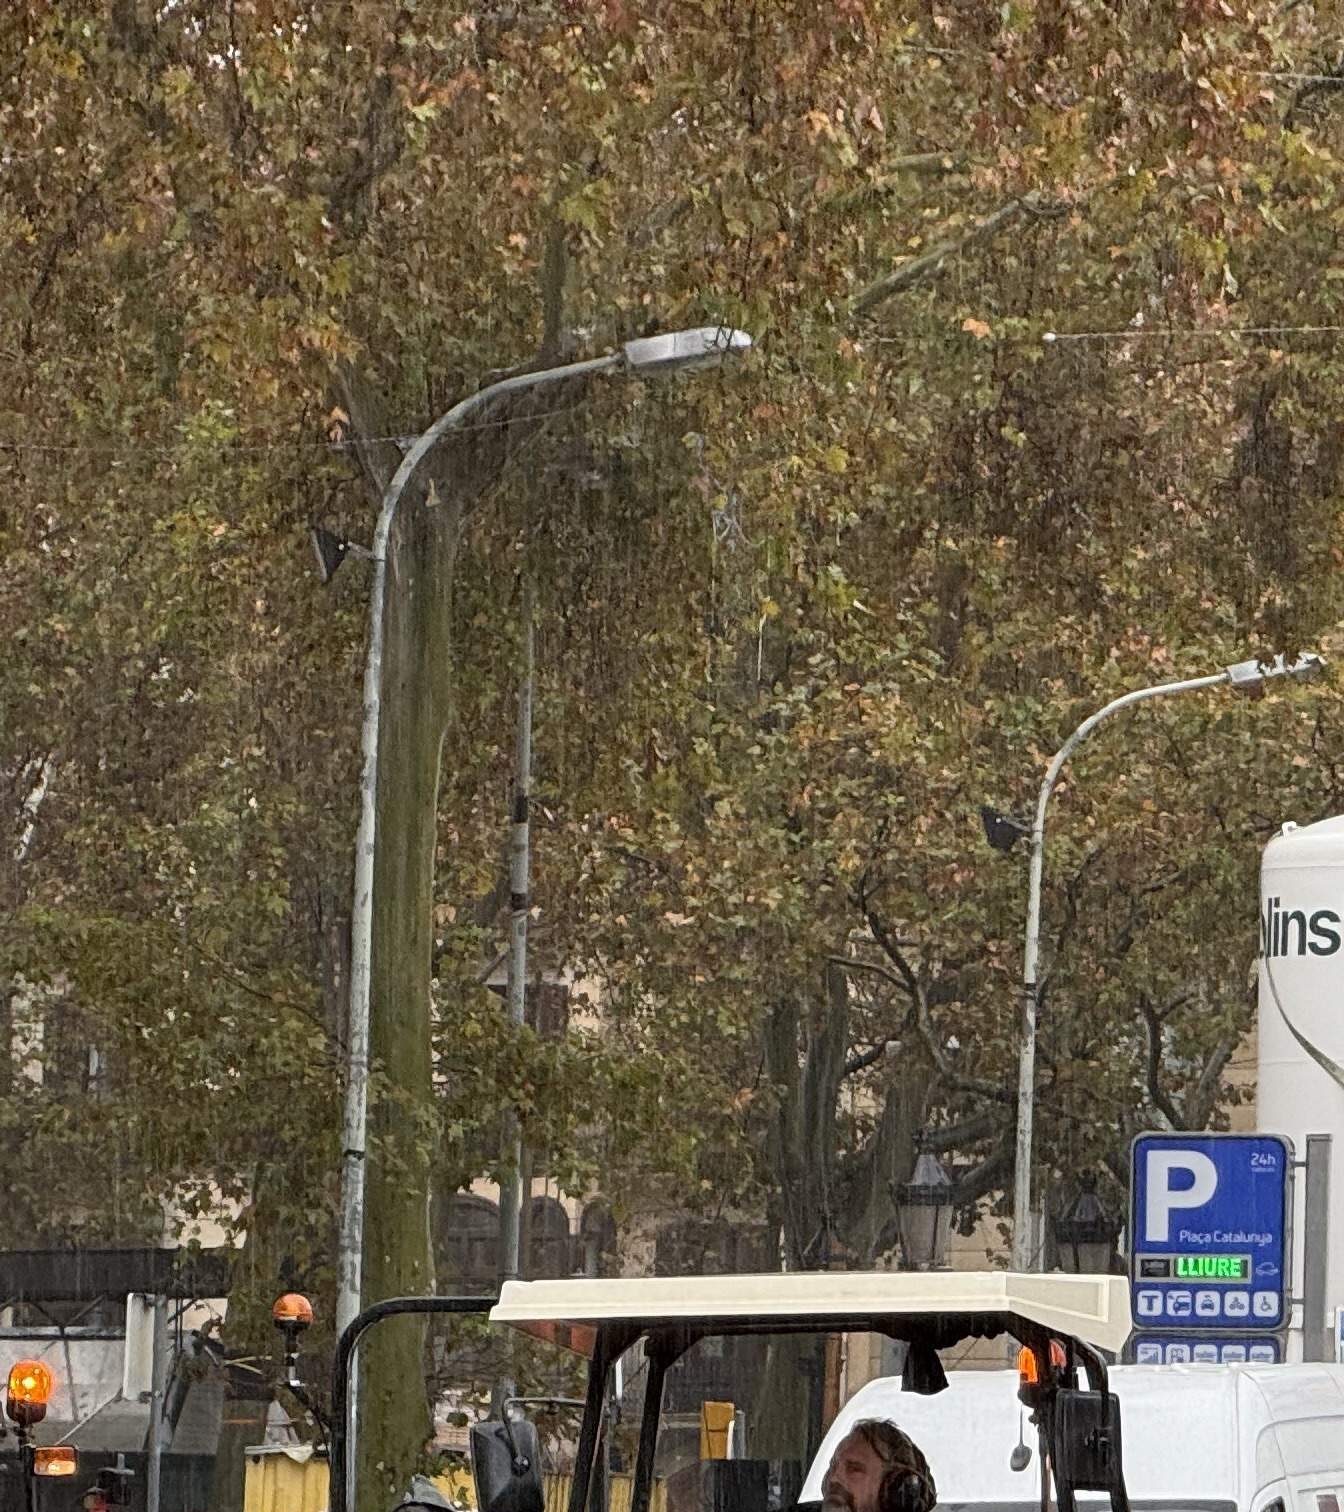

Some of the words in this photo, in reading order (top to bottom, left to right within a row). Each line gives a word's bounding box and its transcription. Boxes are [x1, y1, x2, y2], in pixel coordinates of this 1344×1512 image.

[1146, 1150, 1218, 1242] P
[1251, 1153, 1276, 1166] 24h
[1179, 1230, 1211, 1245] Plaça
[1214, 1230, 1273, 1246] Catalunya
[1177, 1257, 1242, 1278] LLIURE
